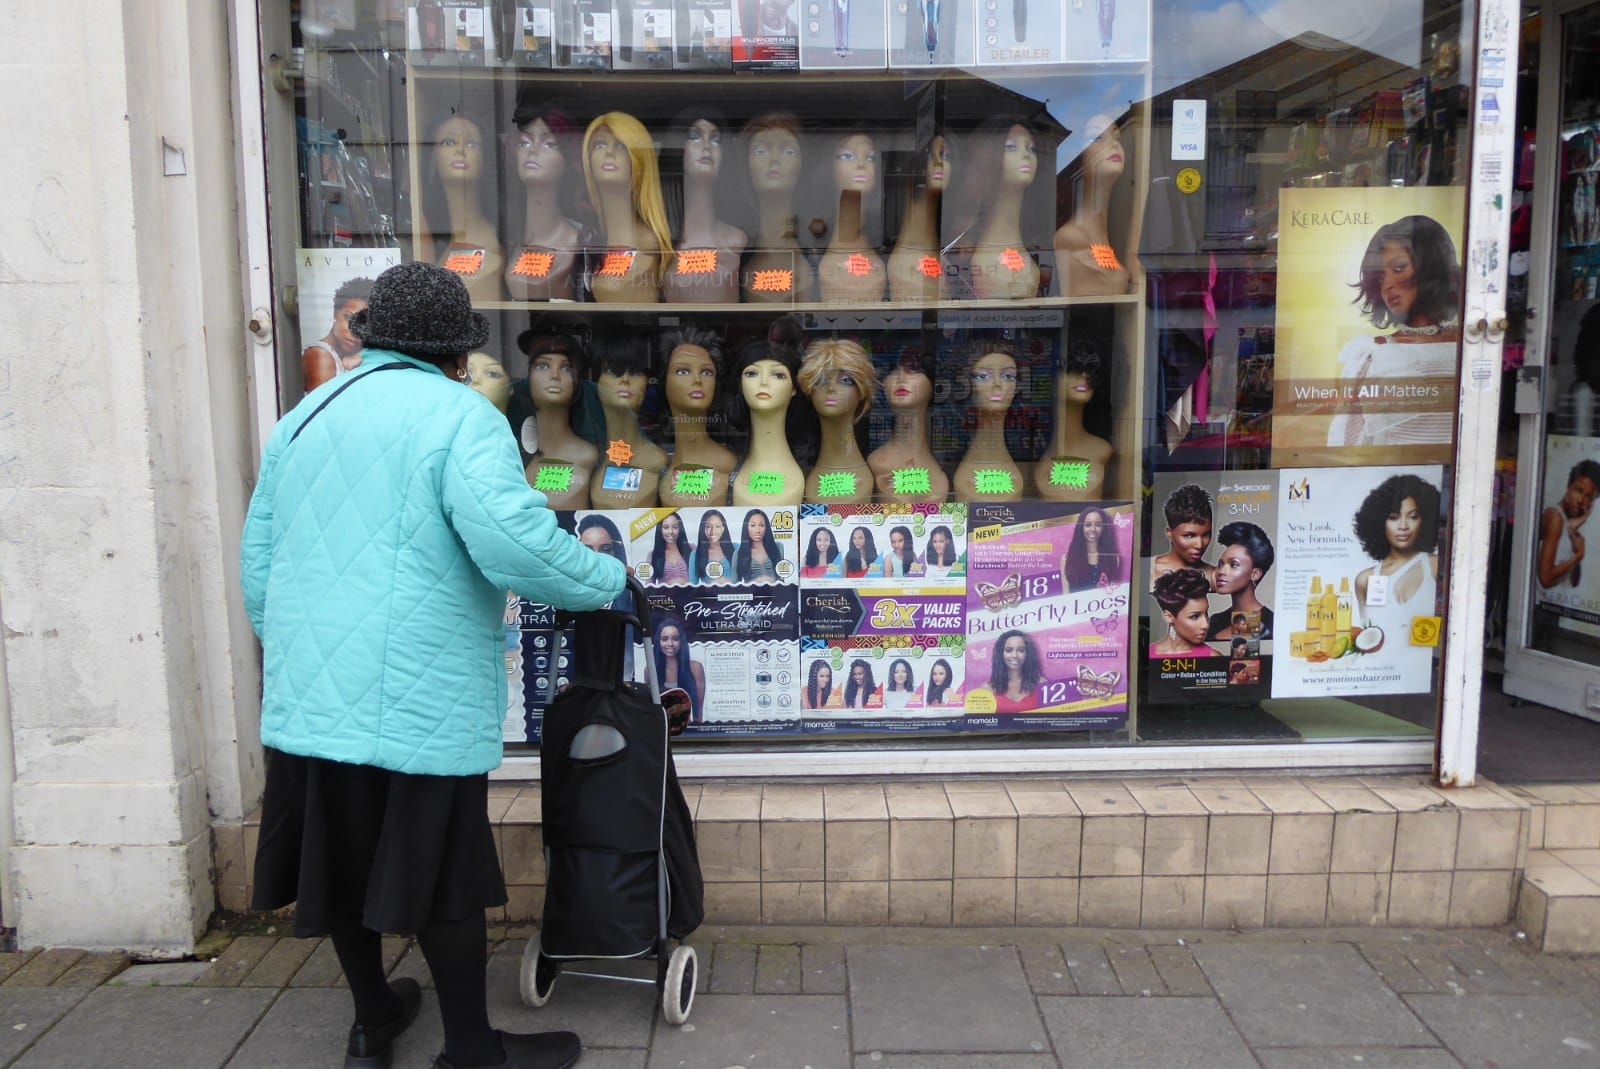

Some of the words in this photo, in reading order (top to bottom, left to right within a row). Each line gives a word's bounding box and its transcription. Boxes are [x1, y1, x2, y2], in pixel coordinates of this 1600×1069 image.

[991, 49, 1050, 60] DETAILER
[1180, 143, 1198, 151] VISA
[304, 256, 394, 267] AVLON
[1294, 385, 1339, 400] When
[1343, 385, 1353, 398] It
[1357, 384, 1379, 398] All
[1383, 384, 1439, 398] Matters
[975, 507, 1014, 517] Cherish
[634, 511, 657, 533] NEW
[771, 511, 794, 530] 46
[1287, 522, 1305, 532] New
[975, 528, 999, 540] NEW!
[1287, 535, 1305, 544] New
[805, 596, 849, 608] Cherish
[683, 601, 791, 621] Pre-Stretched
[923, 602, 962, 616] VALUE
[968, 603, 1067, 635] Butterfly
[1073, 594, 1127, 616] Locs
[504, 614, 548, 625] ULTRA
[700, 620, 735, 630] ULTRA
[921, 616, 962, 629] PACKS
[1180, 671, 1196, 679] Relax
[1199, 670, 1227, 678] Condition
[1302, 673, 1401, 684] www.motionshair.com
